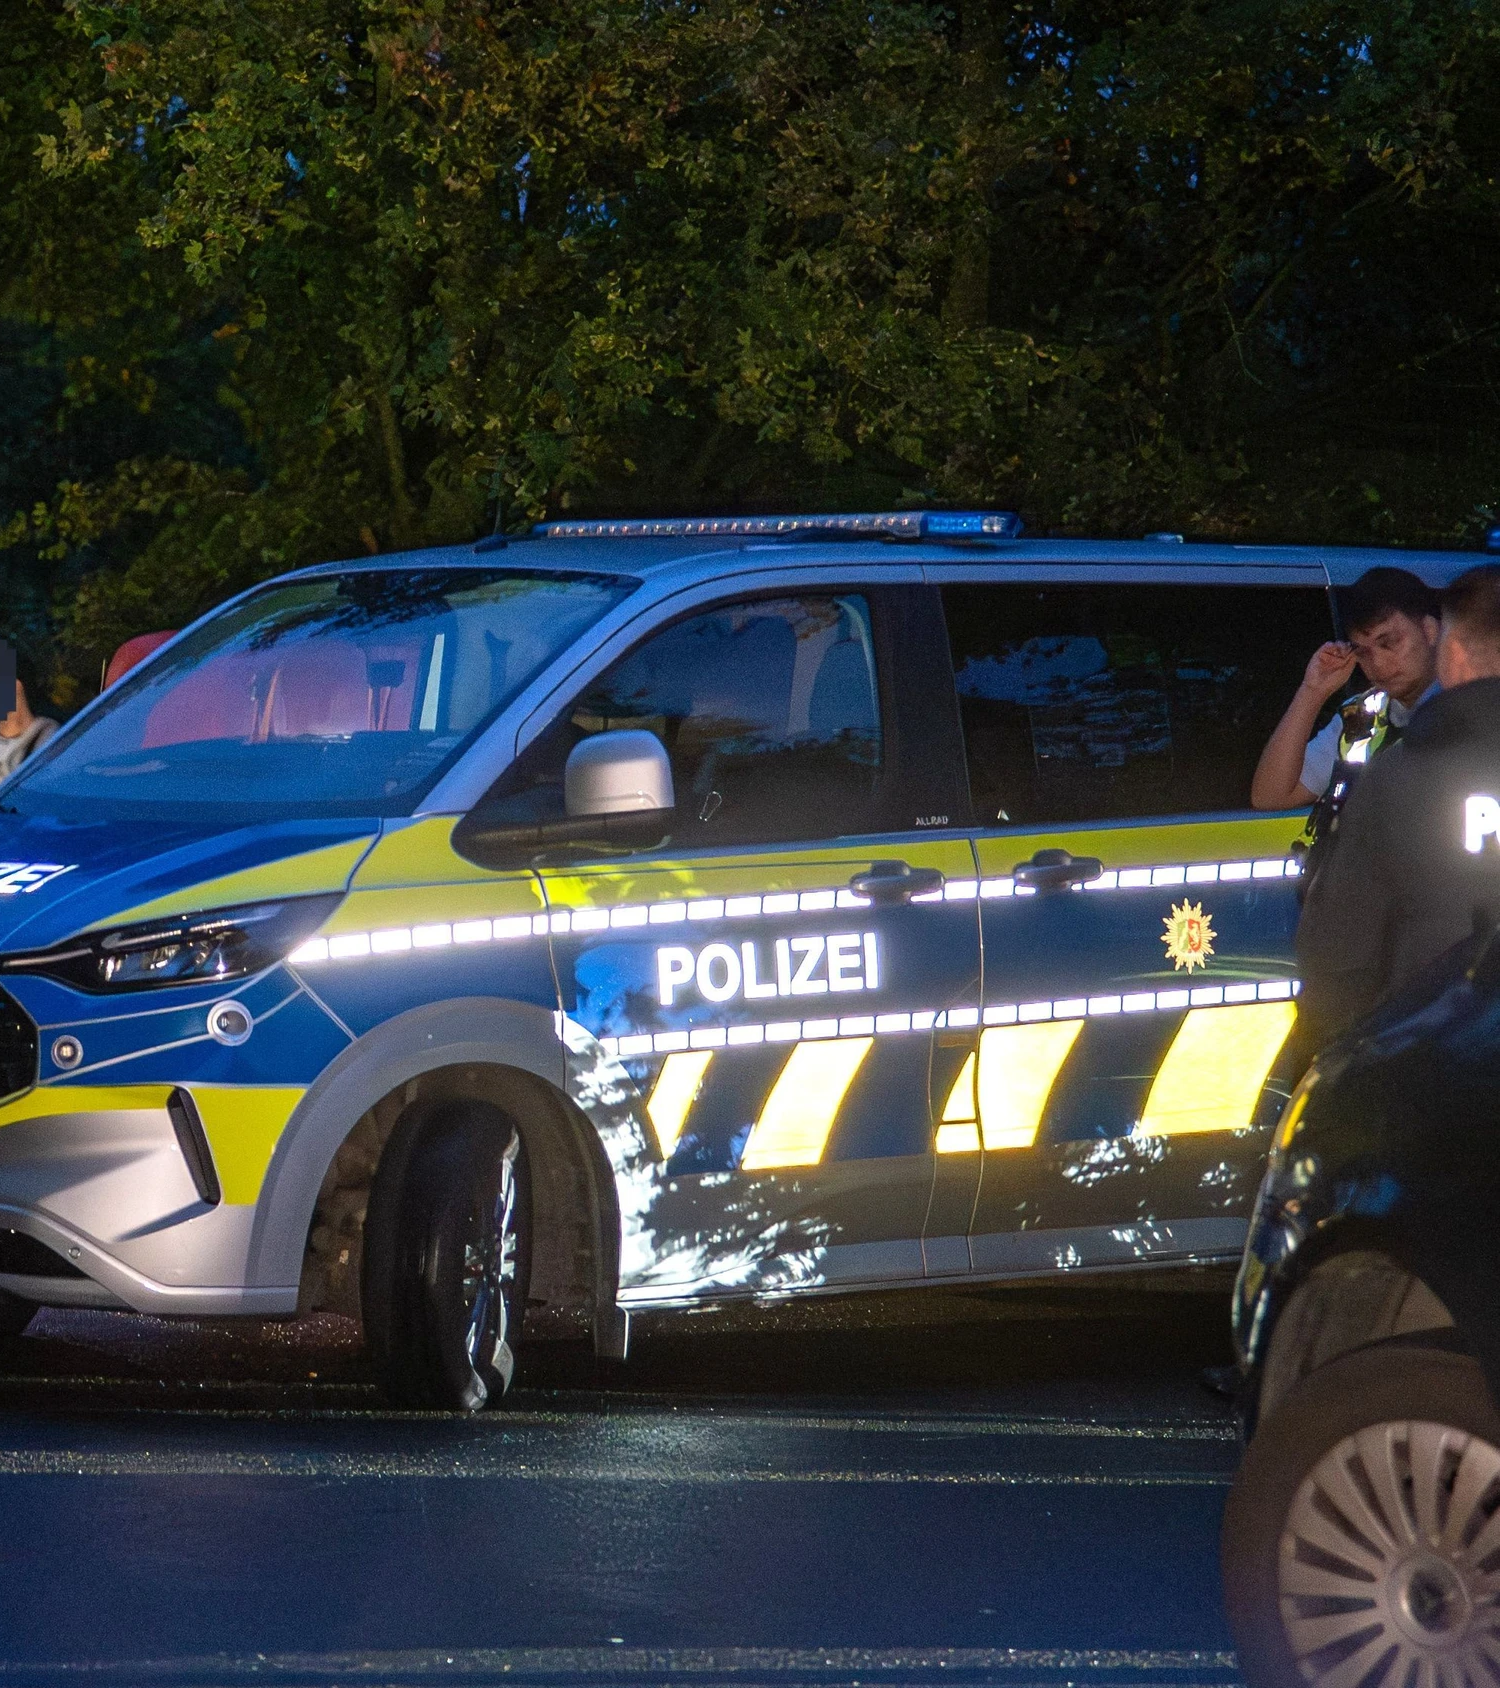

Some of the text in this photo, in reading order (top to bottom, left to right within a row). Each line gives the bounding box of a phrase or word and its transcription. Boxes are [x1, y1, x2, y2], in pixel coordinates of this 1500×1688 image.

[915, 815, 949, 826] ALLRAD
[1465, 796, 1500, 853] P
[657, 932, 881, 1005] POLIZEI
